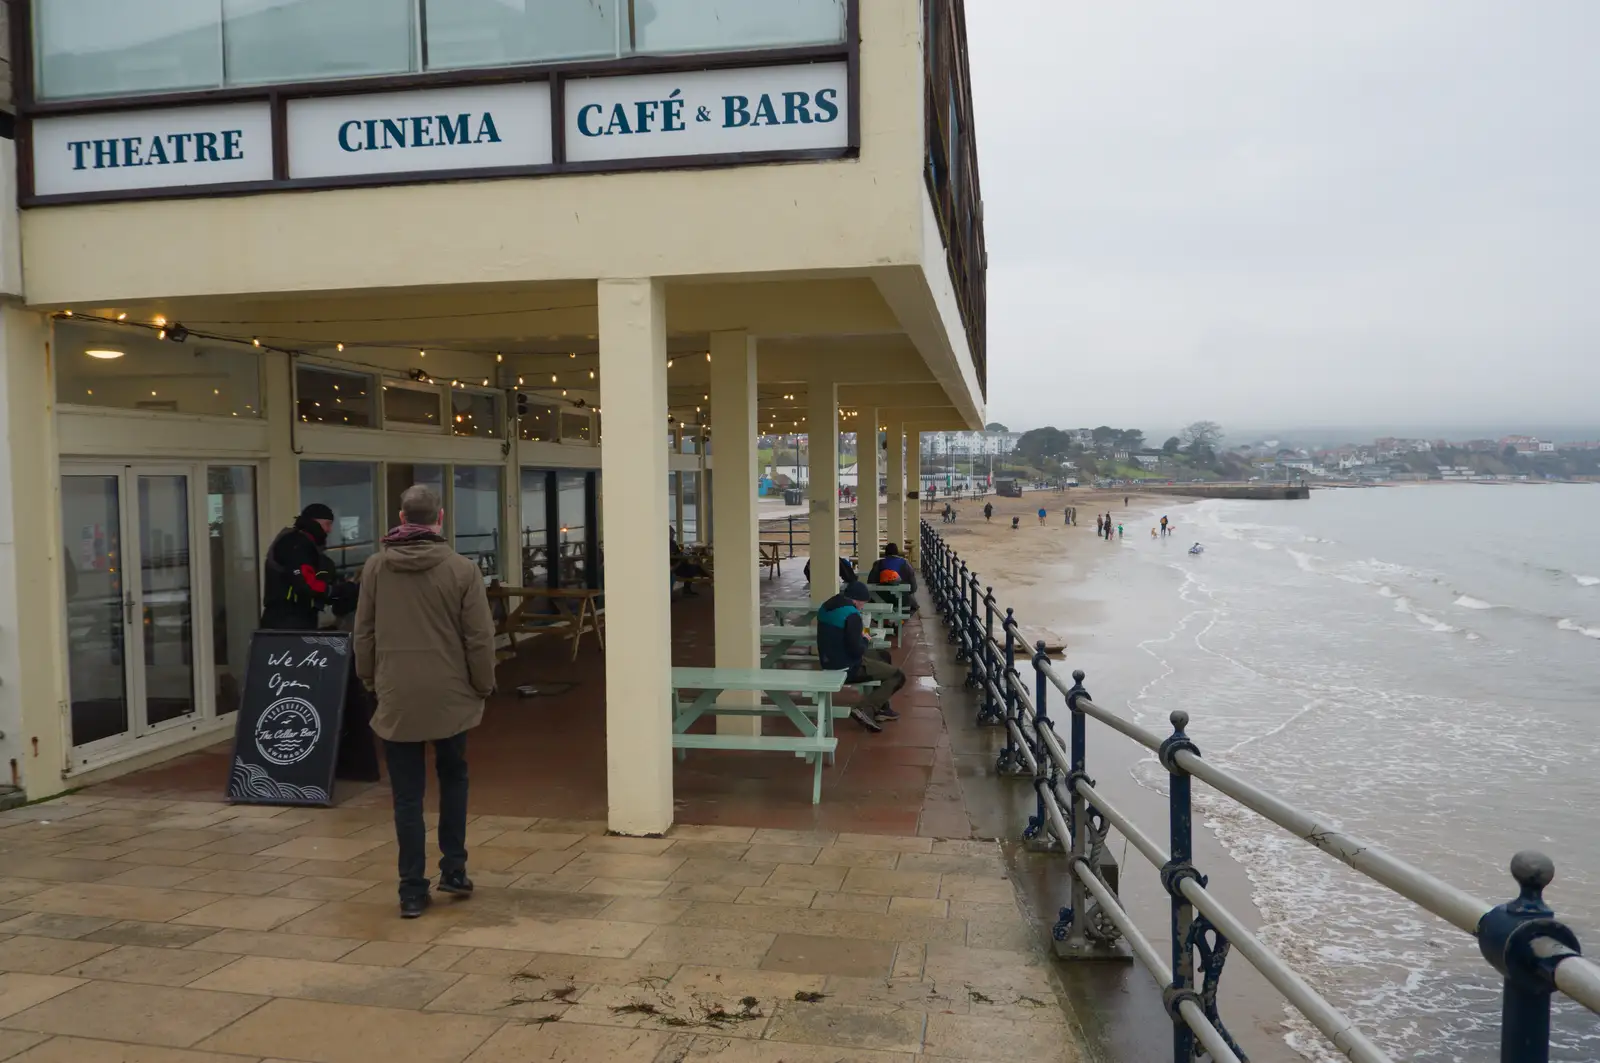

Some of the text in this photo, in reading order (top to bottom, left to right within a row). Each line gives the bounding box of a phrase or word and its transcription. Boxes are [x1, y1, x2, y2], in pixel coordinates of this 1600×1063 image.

[577, 88, 839, 137] CAFÉ & BARS
[338, 112, 502, 152] CINEMA
[67, 129, 244, 170] THEATRE
[268, 650, 328, 668] We Are
[268, 673, 310, 695] Open
[259, 728, 316, 740] The Cellar Bar
